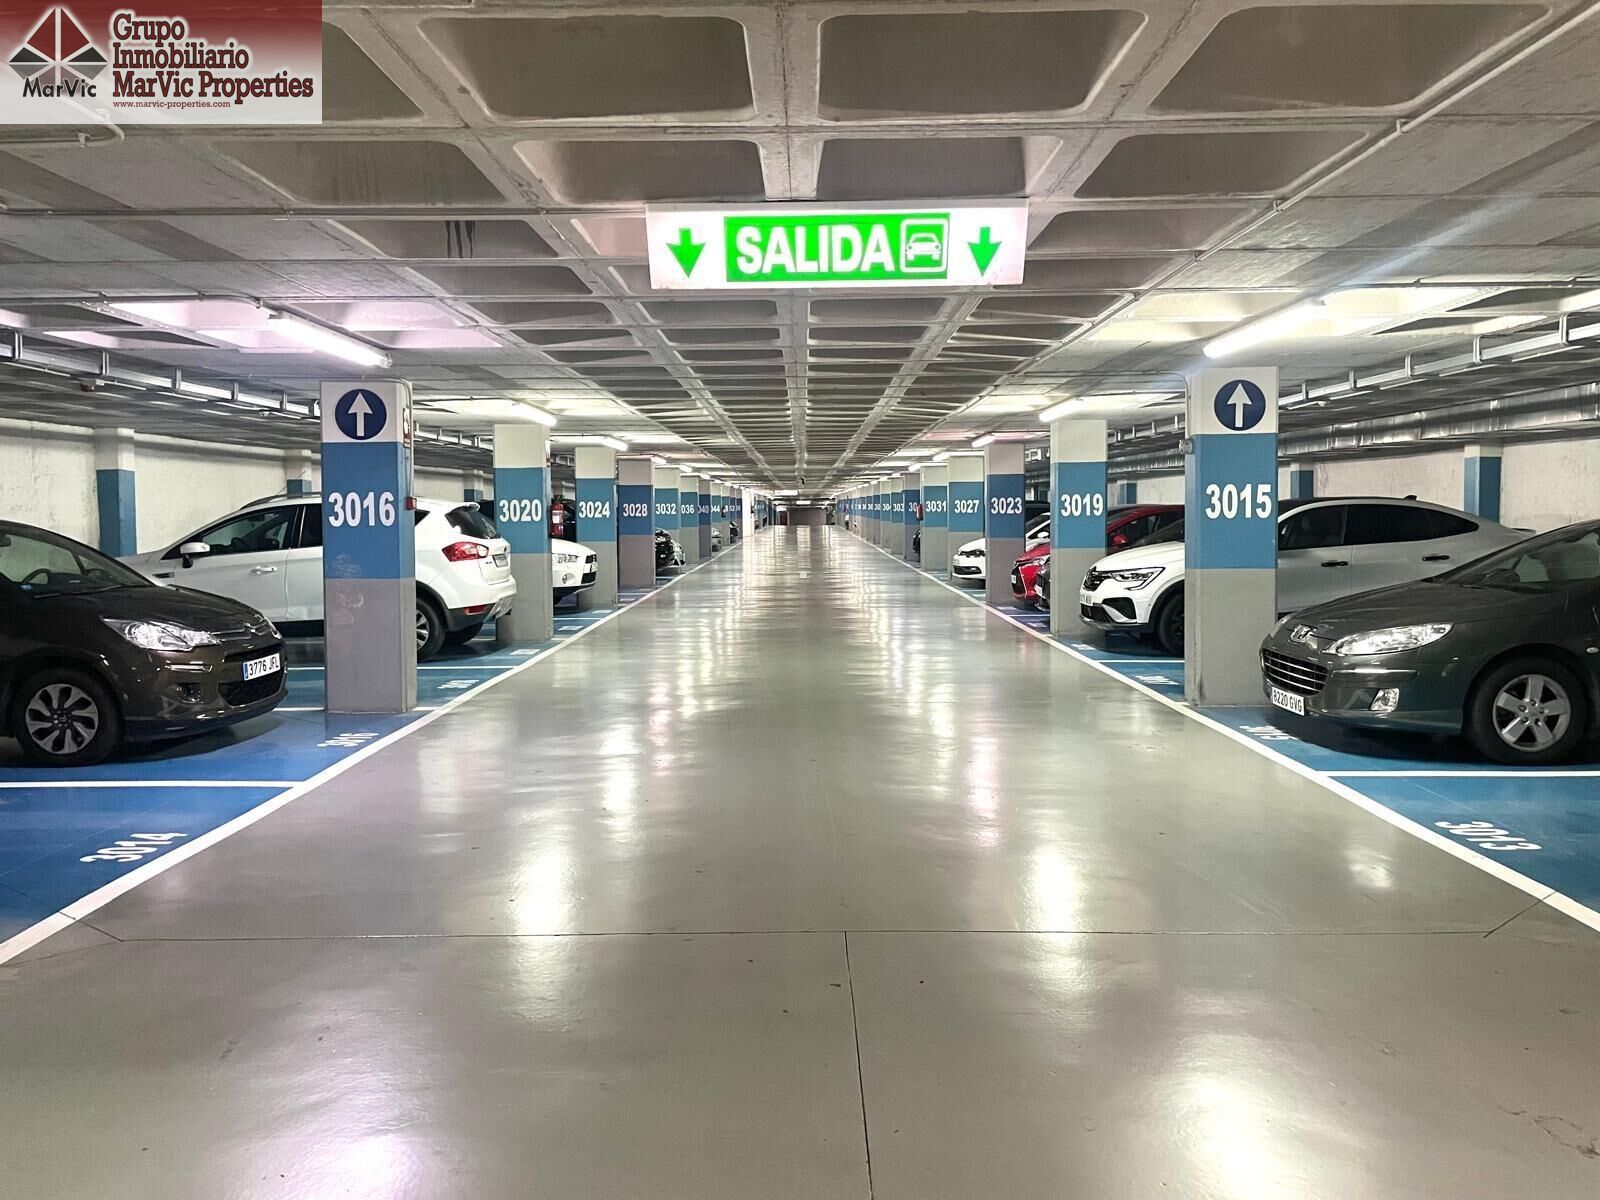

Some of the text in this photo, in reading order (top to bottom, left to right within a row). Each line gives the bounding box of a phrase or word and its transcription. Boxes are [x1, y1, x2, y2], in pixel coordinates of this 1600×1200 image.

[736, 223, 895, 274] SALIDA
[328, 491, 396, 528] 3016
[578, 501, 610, 519] 3024
[622, 503, 648, 517] 3028
[655, 503, 677, 515] 3032
[681, 504, 695, 514] 036
[892, 503, 904, 512] 303
[925, 501, 947, 513] 3031
[954, 500, 979, 513] 3027
[991, 497, 1022, 515] 3023
[1060, 493, 1104, 517] 3019
[1205, 483, 1272, 519] 3015
[499, 499, 542, 522] 3020
[248, 659, 267, 676] 3776
[1434, 820, 1542, 851] 3013
[80, 832, 188, 863] 3014
